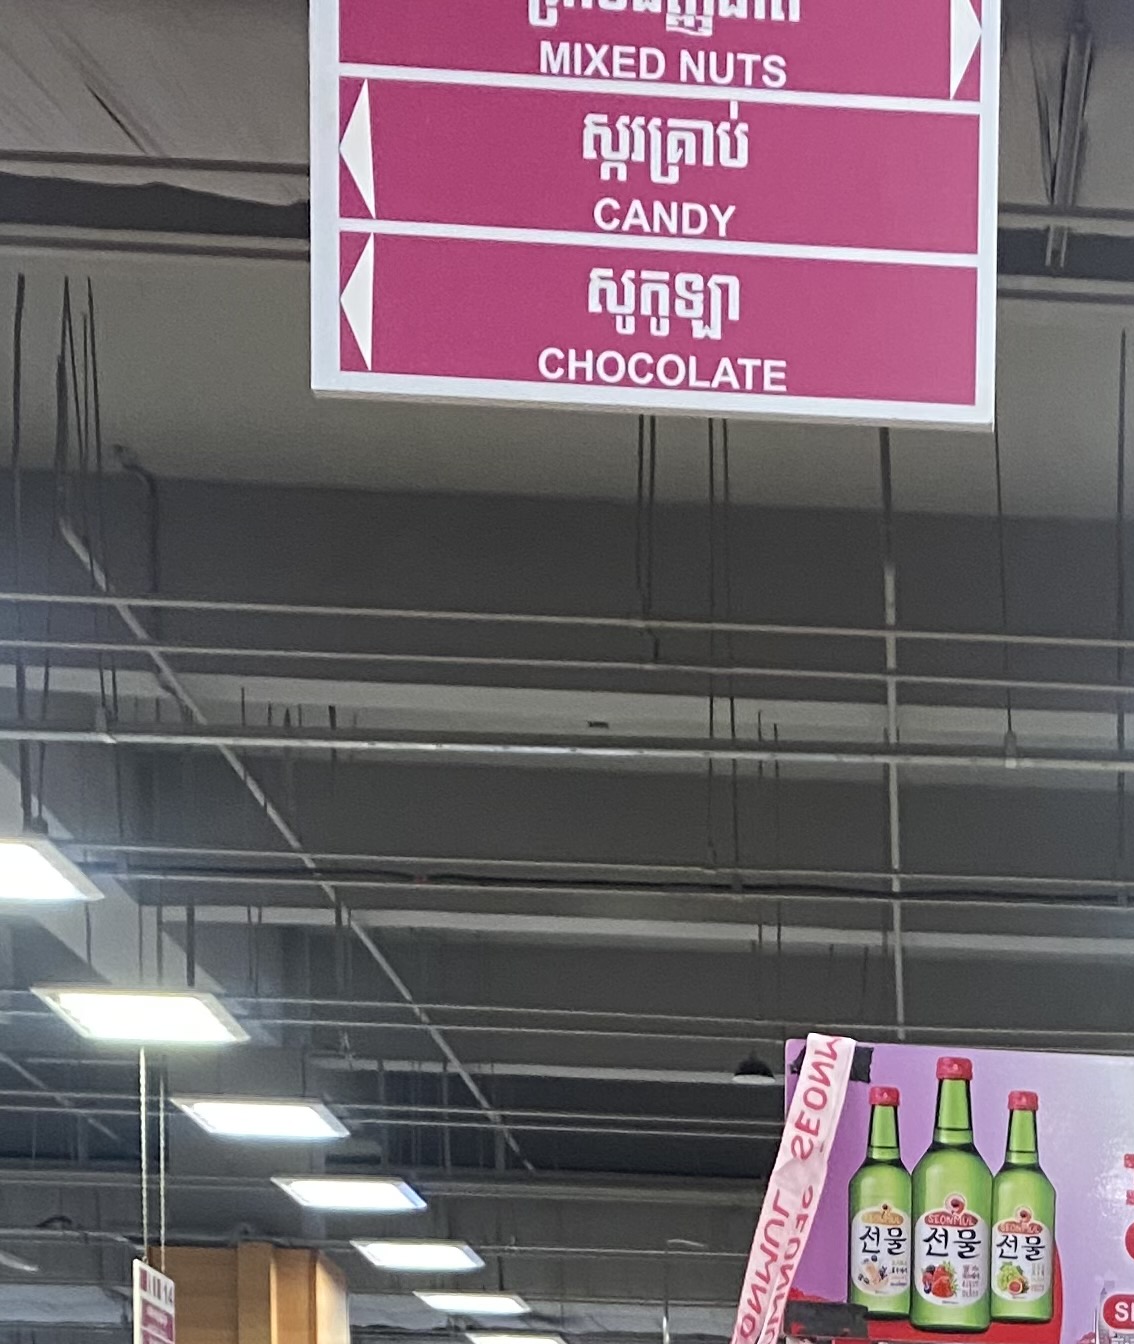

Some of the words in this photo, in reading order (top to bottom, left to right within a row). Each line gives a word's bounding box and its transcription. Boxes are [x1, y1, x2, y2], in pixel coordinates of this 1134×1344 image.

[539, 40, 666, 80] MIXED
[679, 49, 787, 88] NUTS
[593, 197, 736, 238] CANDY
[537, 346, 787, 392] CHOCOLATE
